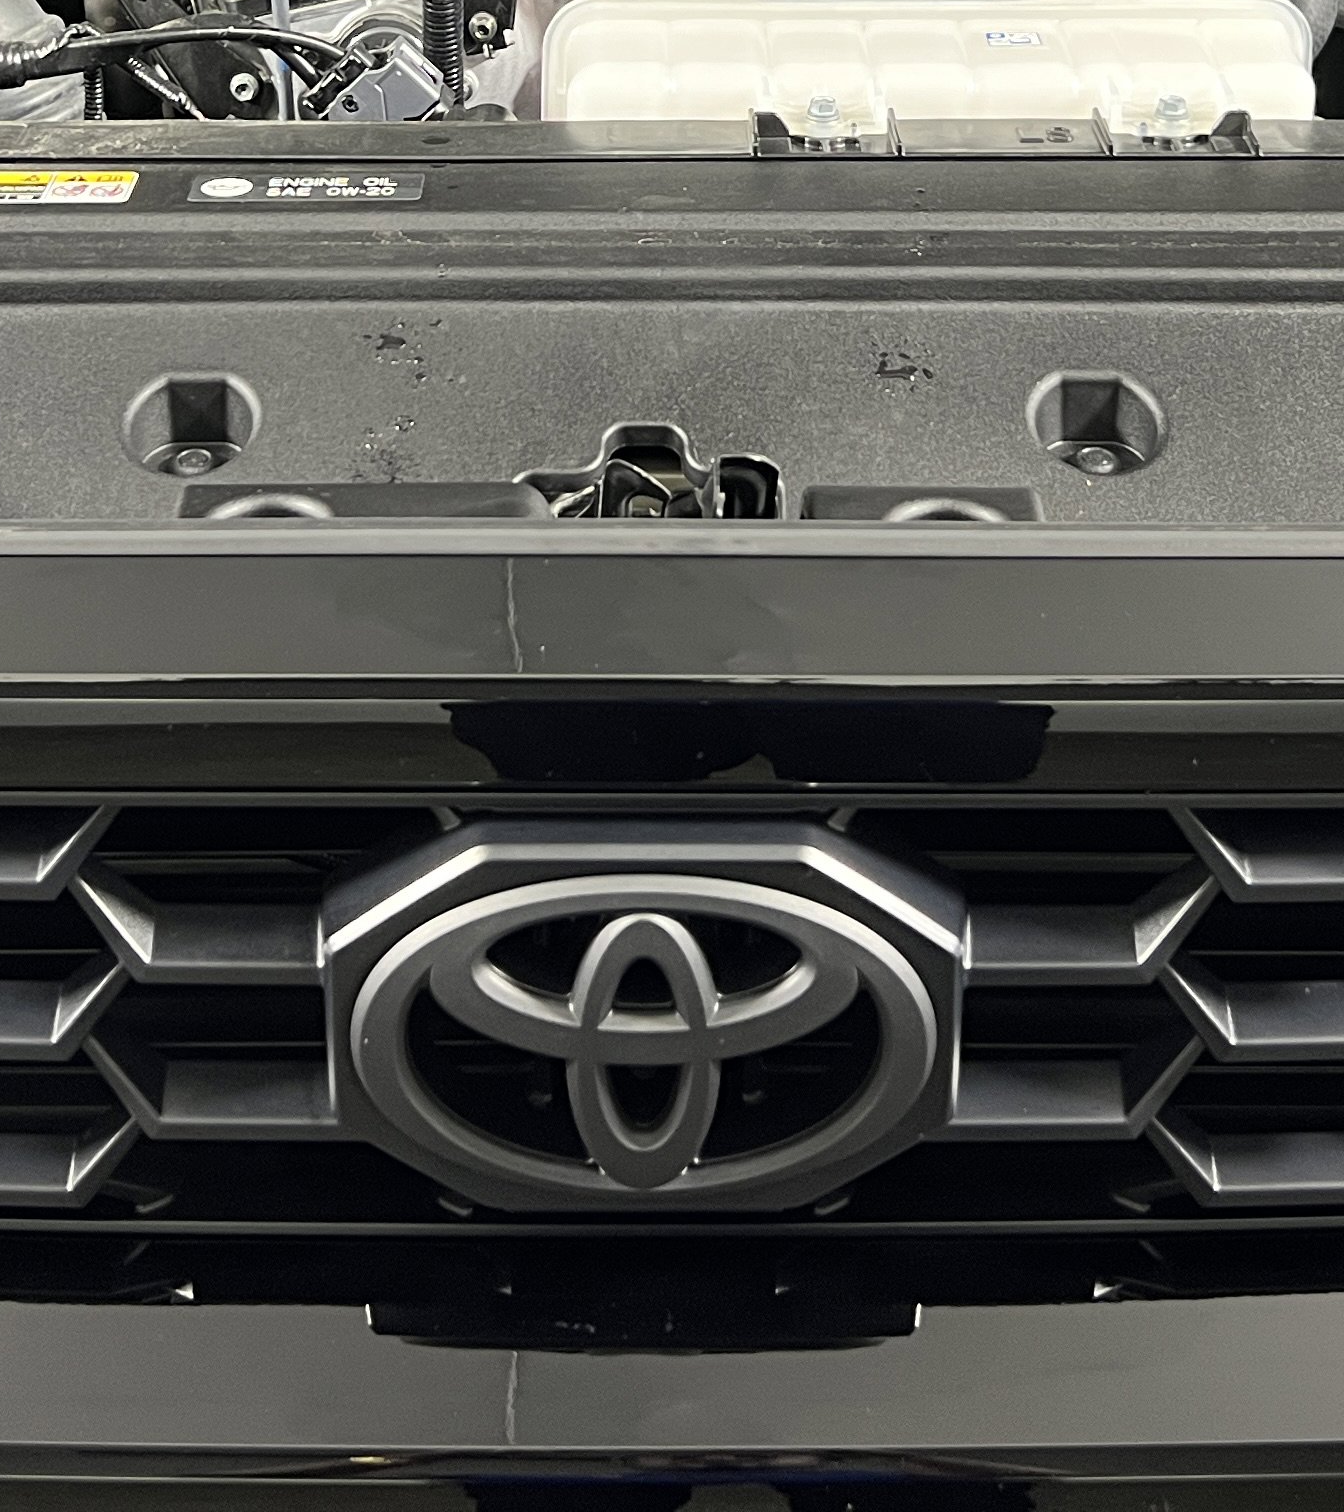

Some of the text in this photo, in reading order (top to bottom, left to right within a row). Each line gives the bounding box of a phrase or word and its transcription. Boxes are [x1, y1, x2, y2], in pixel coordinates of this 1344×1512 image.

[268, 176, 398, 187] ENGINE OIL
[265, 186, 396, 197] SAE 0W-20
